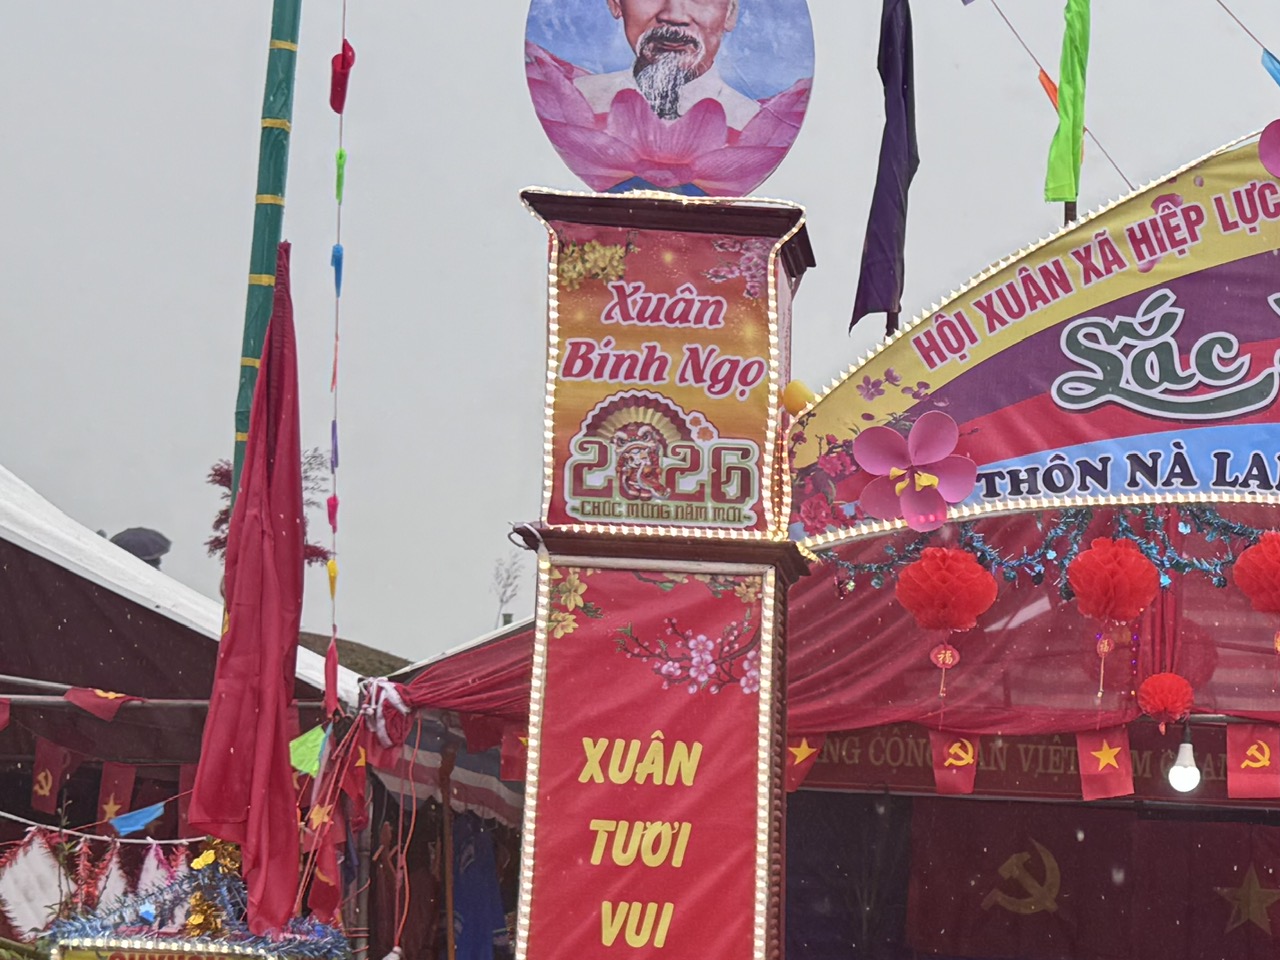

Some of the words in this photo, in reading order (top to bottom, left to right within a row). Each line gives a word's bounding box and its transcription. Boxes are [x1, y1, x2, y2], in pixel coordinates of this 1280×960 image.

[601, 282, 727, 329] Xuân
[912, 313, 979, 370] HỘI
[972, 258, 1075, 335] XUÂN
[1070, 228, 1128, 286] XÃ
[1125, 204, 1205, 262] HIỆP
[561, 338, 671, 382] Bính
[678, 344, 765, 400] Ngọ
[1052, 289, 1278, 418] Sắc
[977, 453, 1113, 499] THÔN
[1126, 440, 1198, 490] NÀ
[577, 730, 702, 786] XUÂN
[588, 820, 691, 867] TƯƠI
[601, 901, 674, 948] VUI
